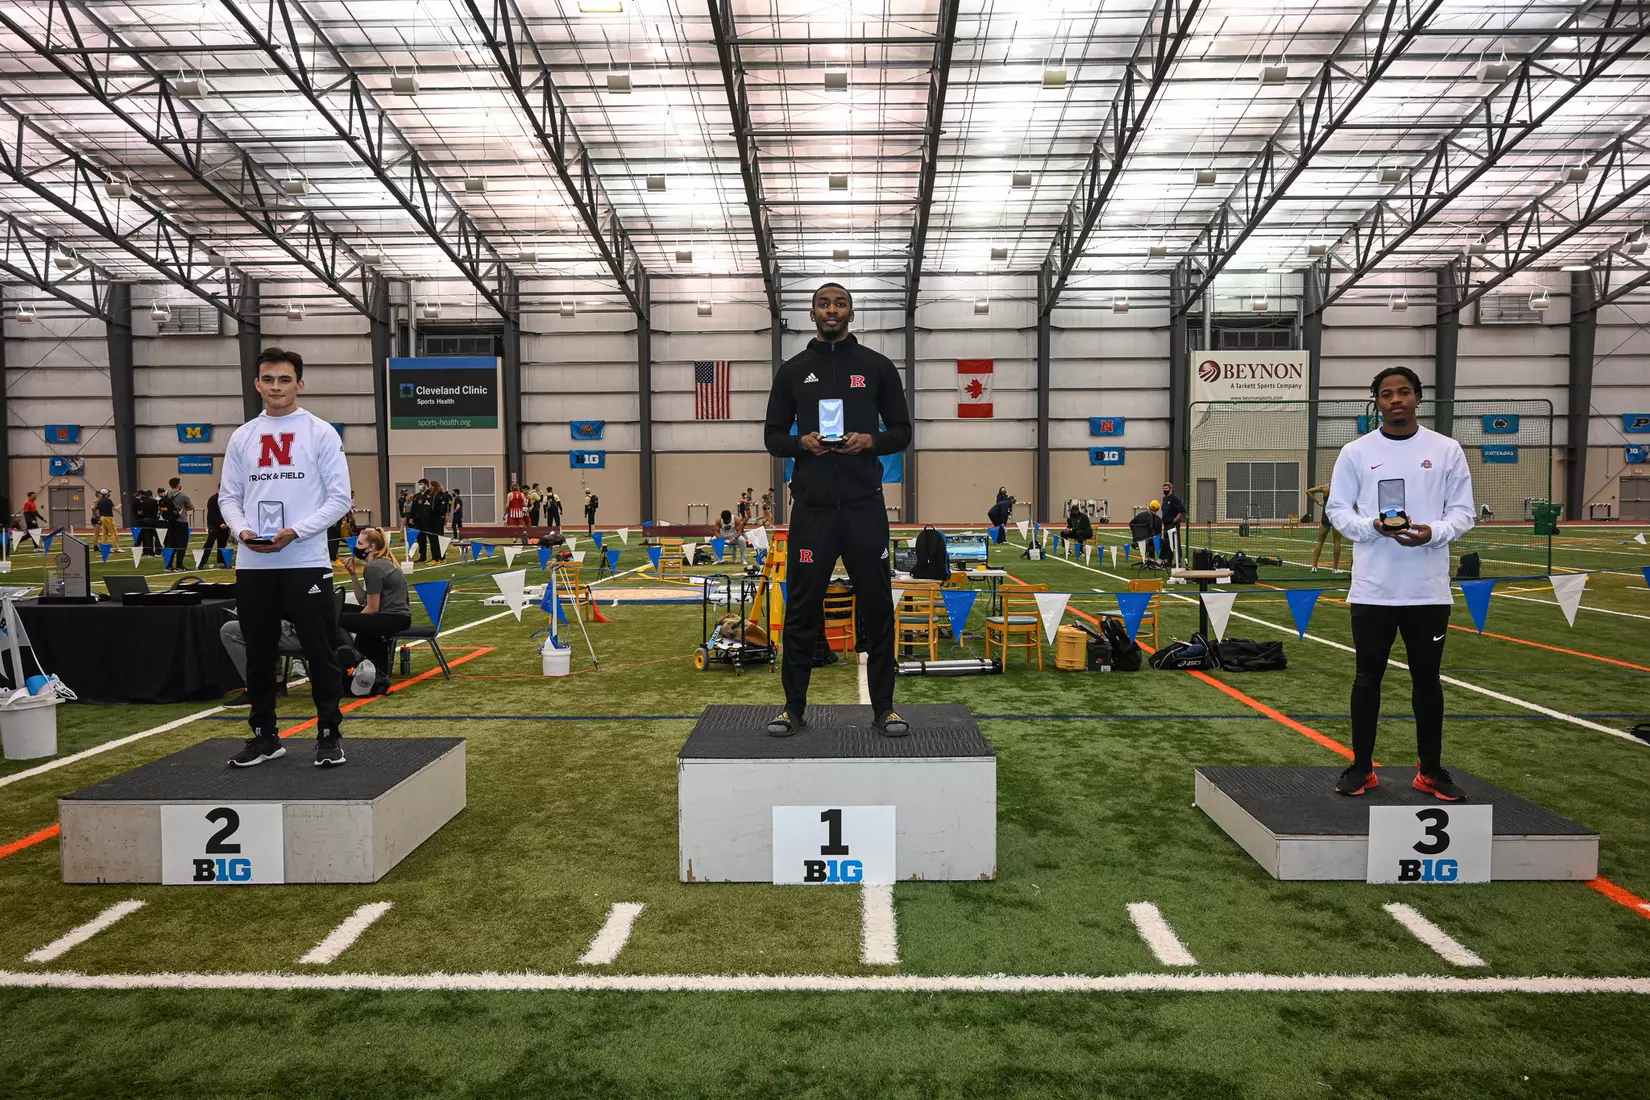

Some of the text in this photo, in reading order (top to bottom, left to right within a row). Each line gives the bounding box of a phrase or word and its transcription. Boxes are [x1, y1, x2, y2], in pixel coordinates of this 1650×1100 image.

[1223, 363, 1303, 379] BEYNON
[850, 374, 866, 388] R
[1257, 382, 1276, 390] Sports
[1277, 382, 1302, 390] Company
[416, 385, 488, 395] Cleveland Clinic
[417, 398, 435, 406] Sports
[417, 418, 471, 428] sports-health.org
[1101, 420, 1113, 432] N
[1632, 417, 1650, 429] P
[57, 427, 69, 440] M
[186, 426, 203, 439] M
[258, 432, 296, 468] N
[272, 472, 279, 480] &
[280, 471, 305, 480] FIELD
[799, 549, 814, 563] R
[205, 807, 241, 854] 2
[820, 808, 849, 855] 1
[1412, 808, 1451, 855] 3
